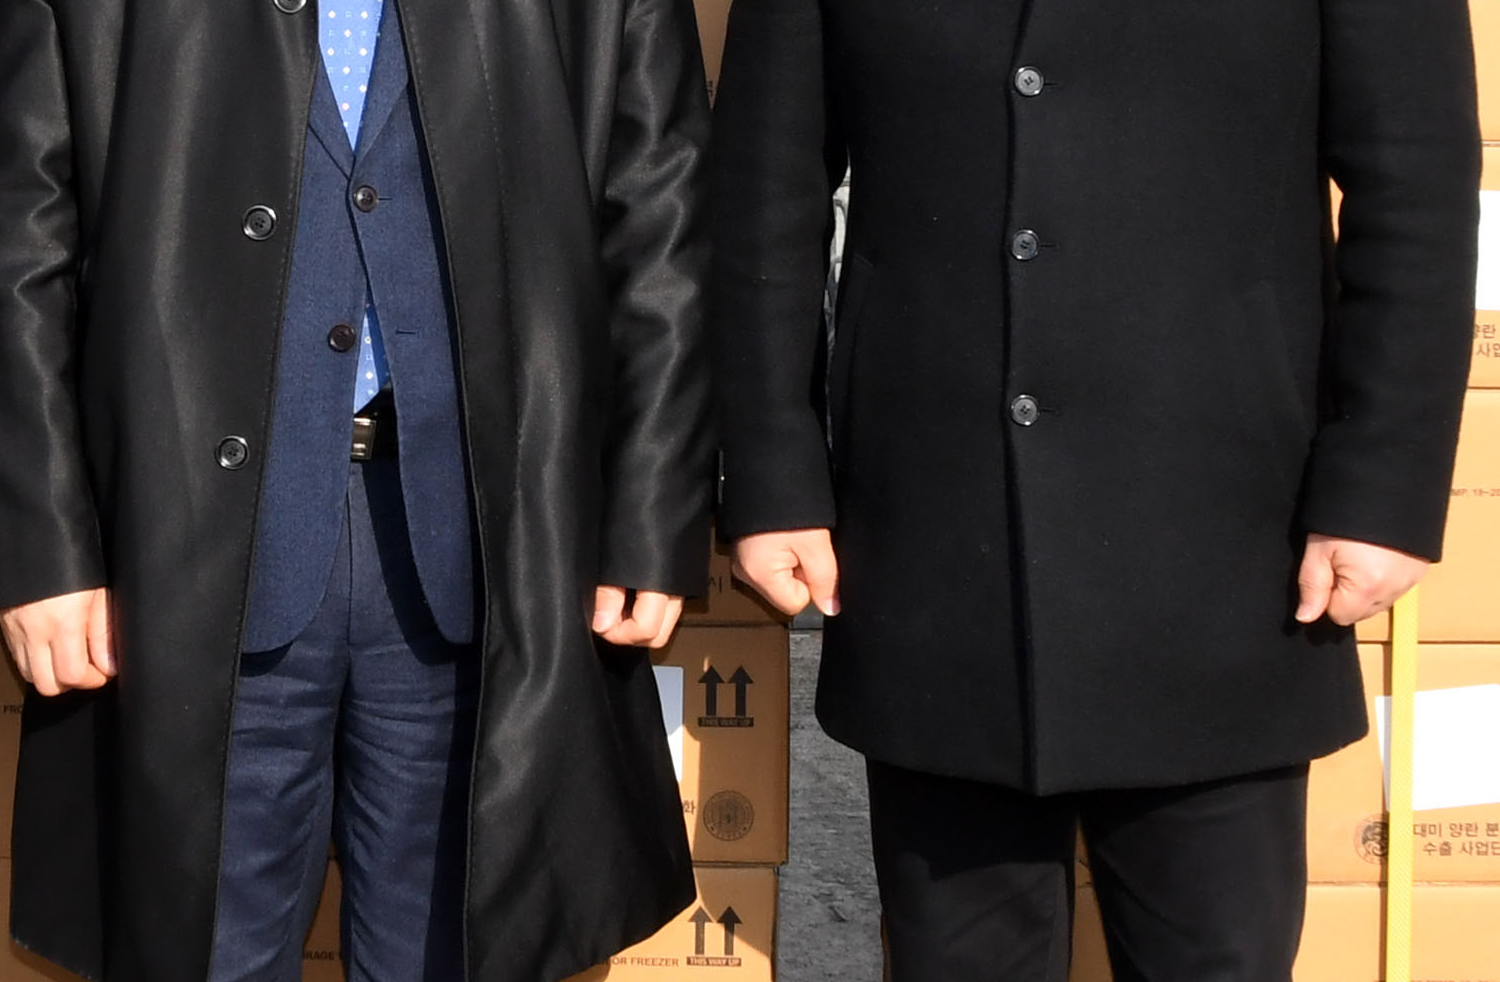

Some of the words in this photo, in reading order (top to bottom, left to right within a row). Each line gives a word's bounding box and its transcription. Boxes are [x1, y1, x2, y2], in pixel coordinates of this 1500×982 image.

[1413, 823, 1442, 837] 대미
[1449, 823, 1478, 837] 양란
[1422, 841, 1452, 857] 수출
[611, 956, 627, 966] OR
[630, 956, 679, 966] FREEZER
